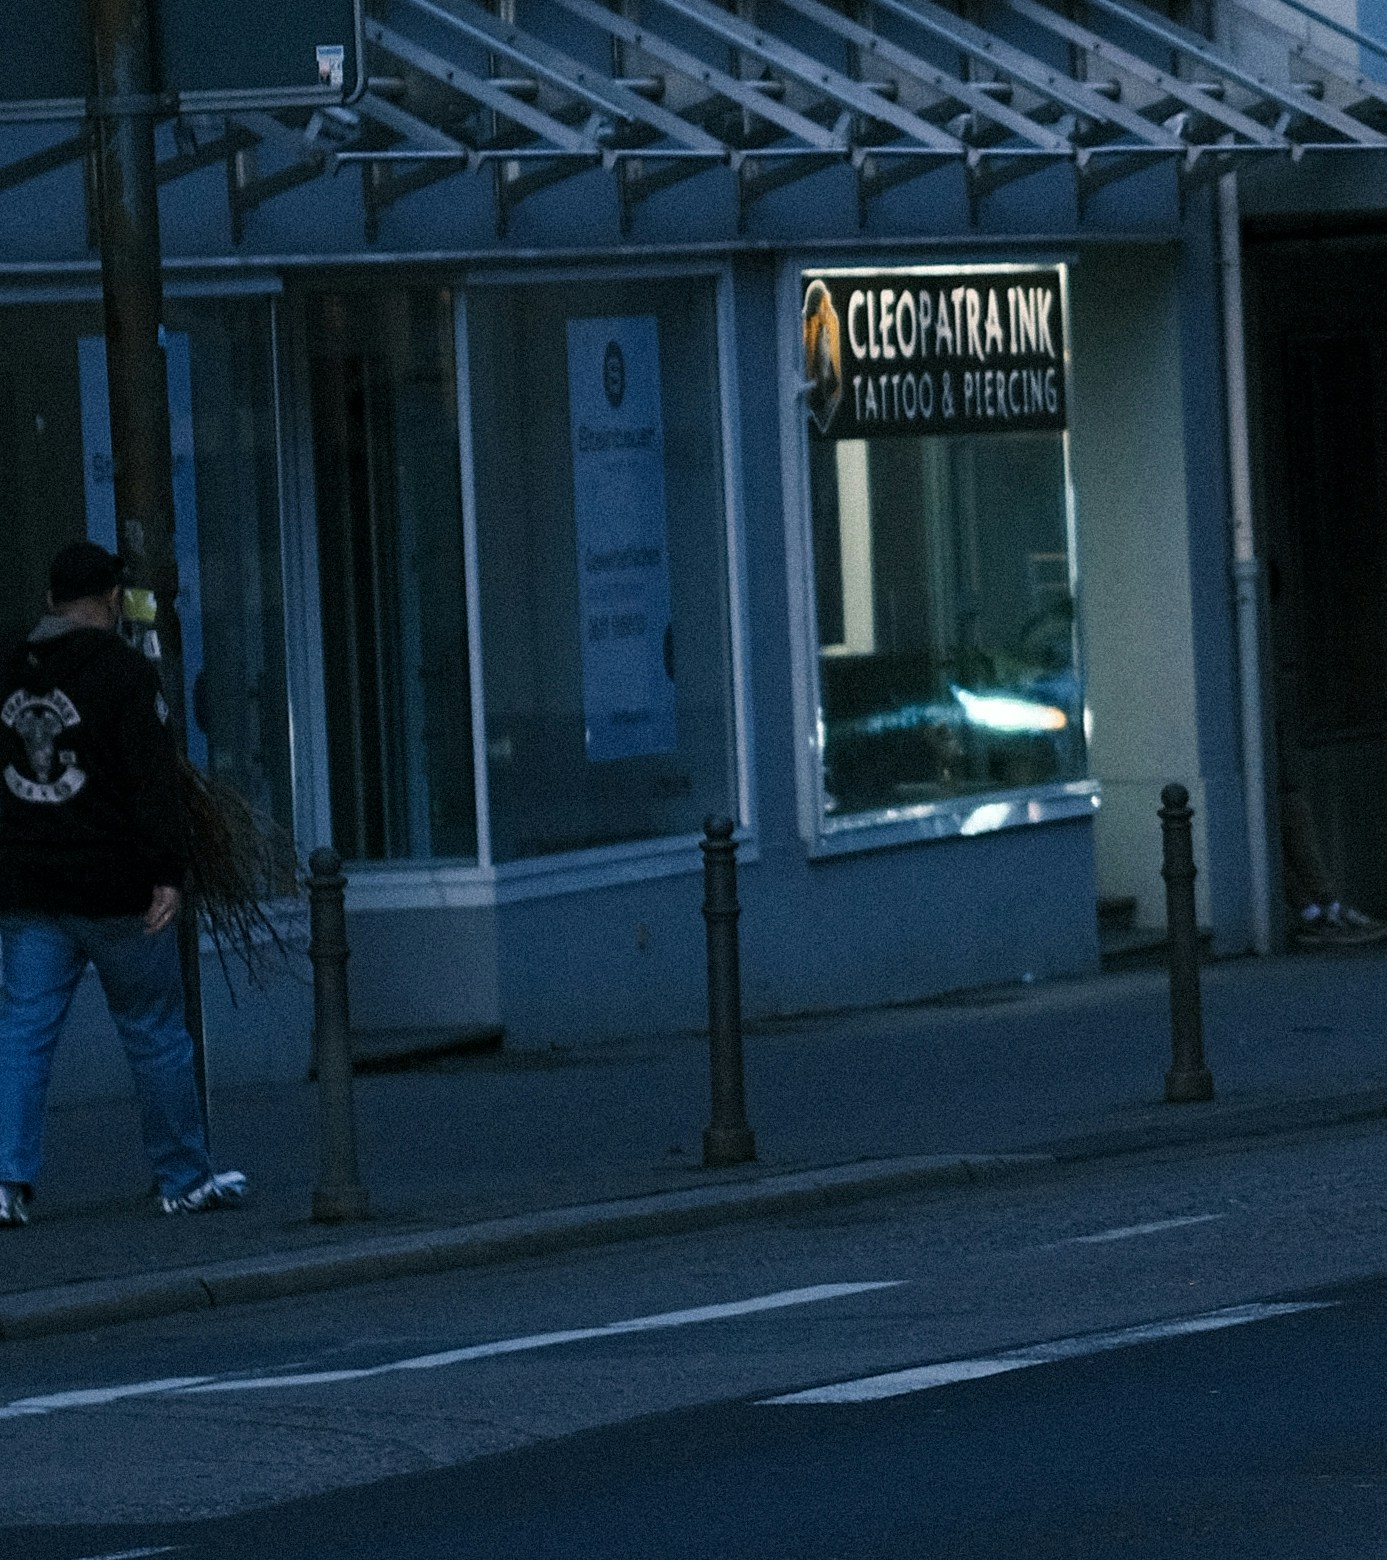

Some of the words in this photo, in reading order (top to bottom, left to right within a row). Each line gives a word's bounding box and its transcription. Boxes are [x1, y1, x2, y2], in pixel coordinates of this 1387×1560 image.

[848, 285, 1002, 361] CLEOPATRA
[1007, 285, 1055, 359] INK
[852, 372, 933, 420] TATTOO
[942, 371, 955, 418] &
[963, 368, 1058, 419] PIERCING
